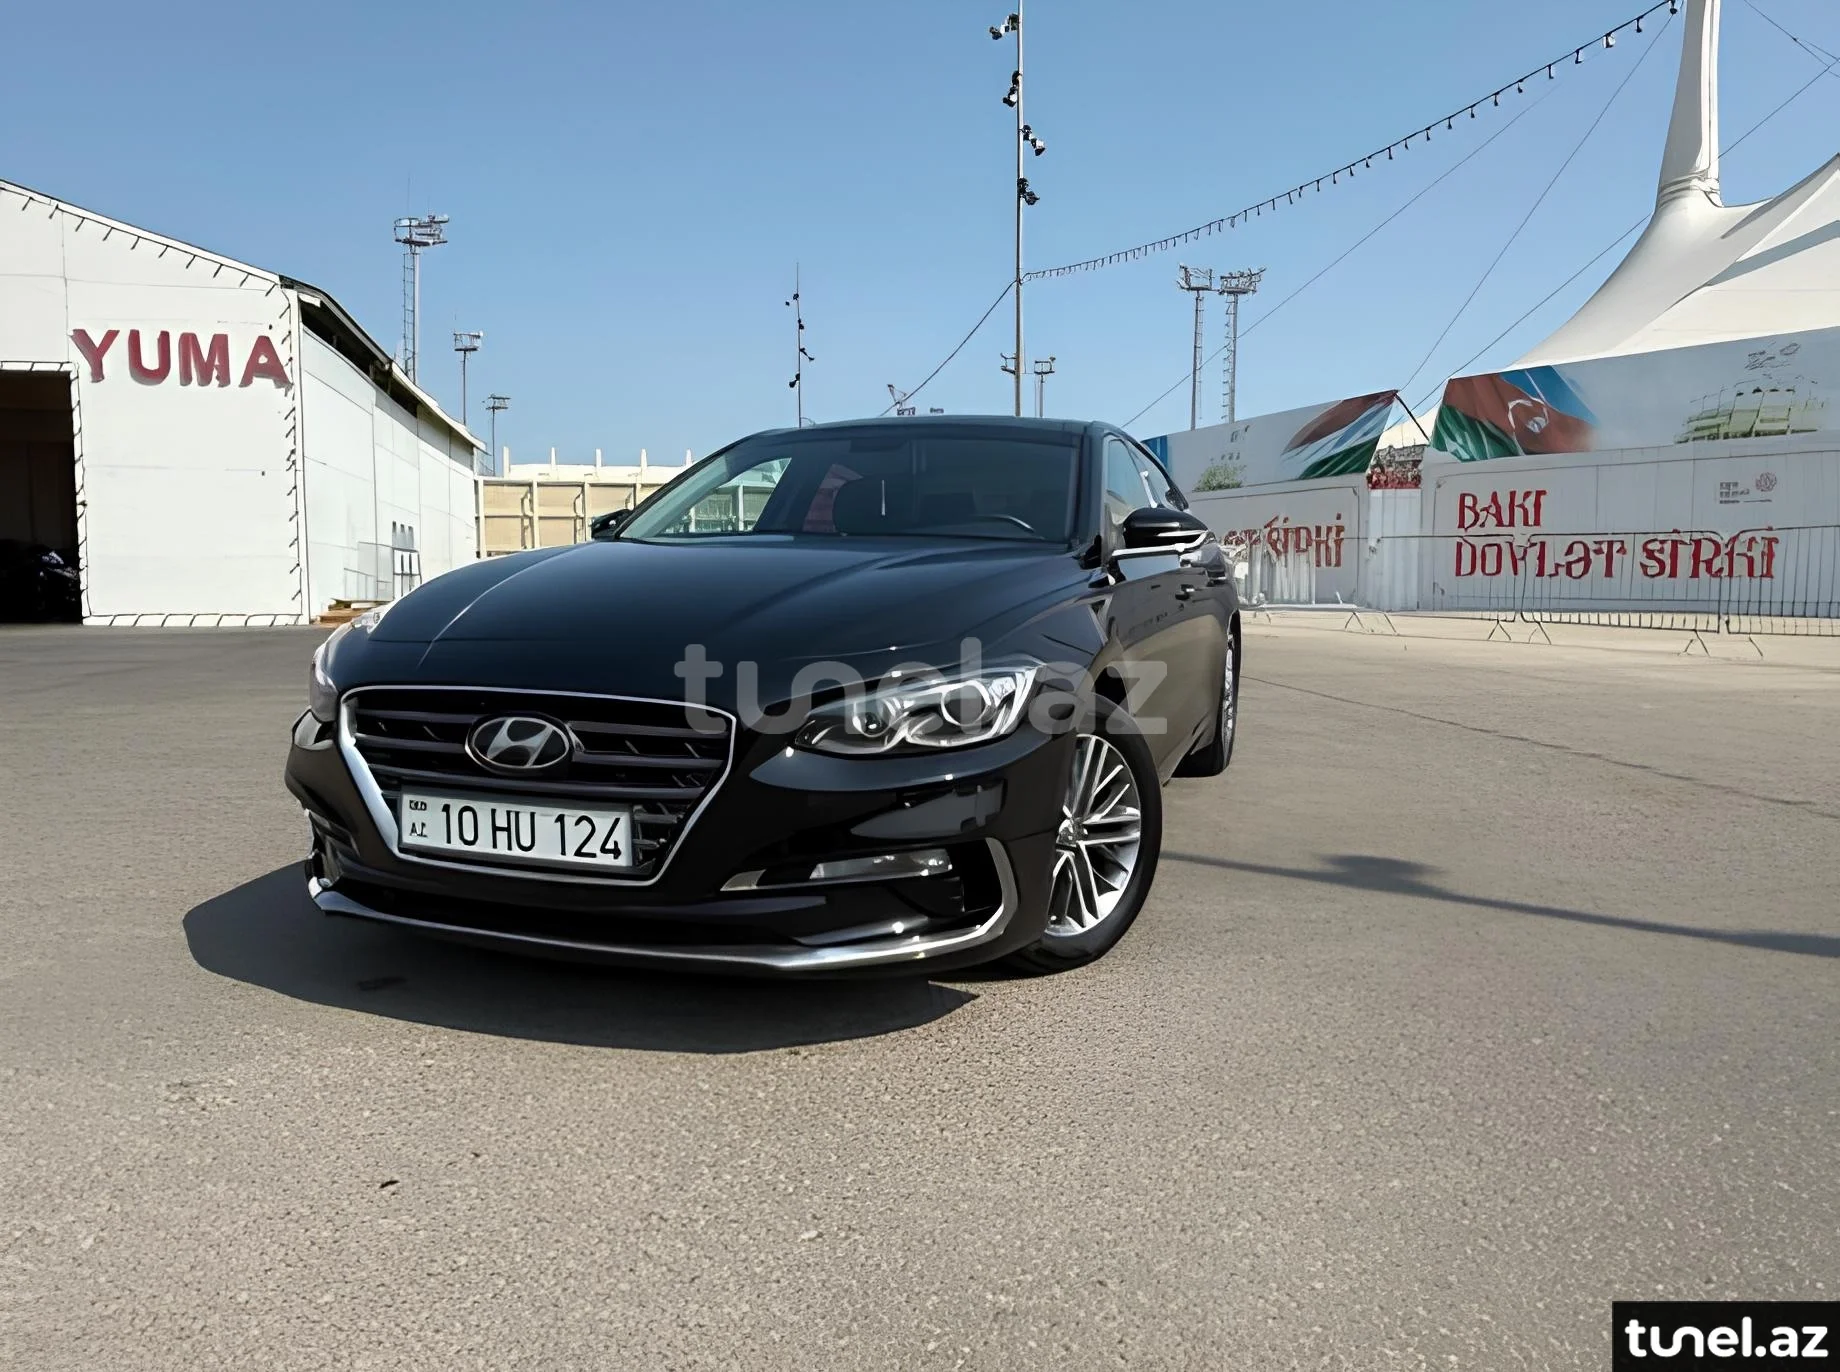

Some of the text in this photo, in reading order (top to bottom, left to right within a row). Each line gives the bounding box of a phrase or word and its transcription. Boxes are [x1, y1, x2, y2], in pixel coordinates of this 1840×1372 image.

[72, 328, 292, 388] YUMA
[442, 803, 622, 860] 10 HU 124
